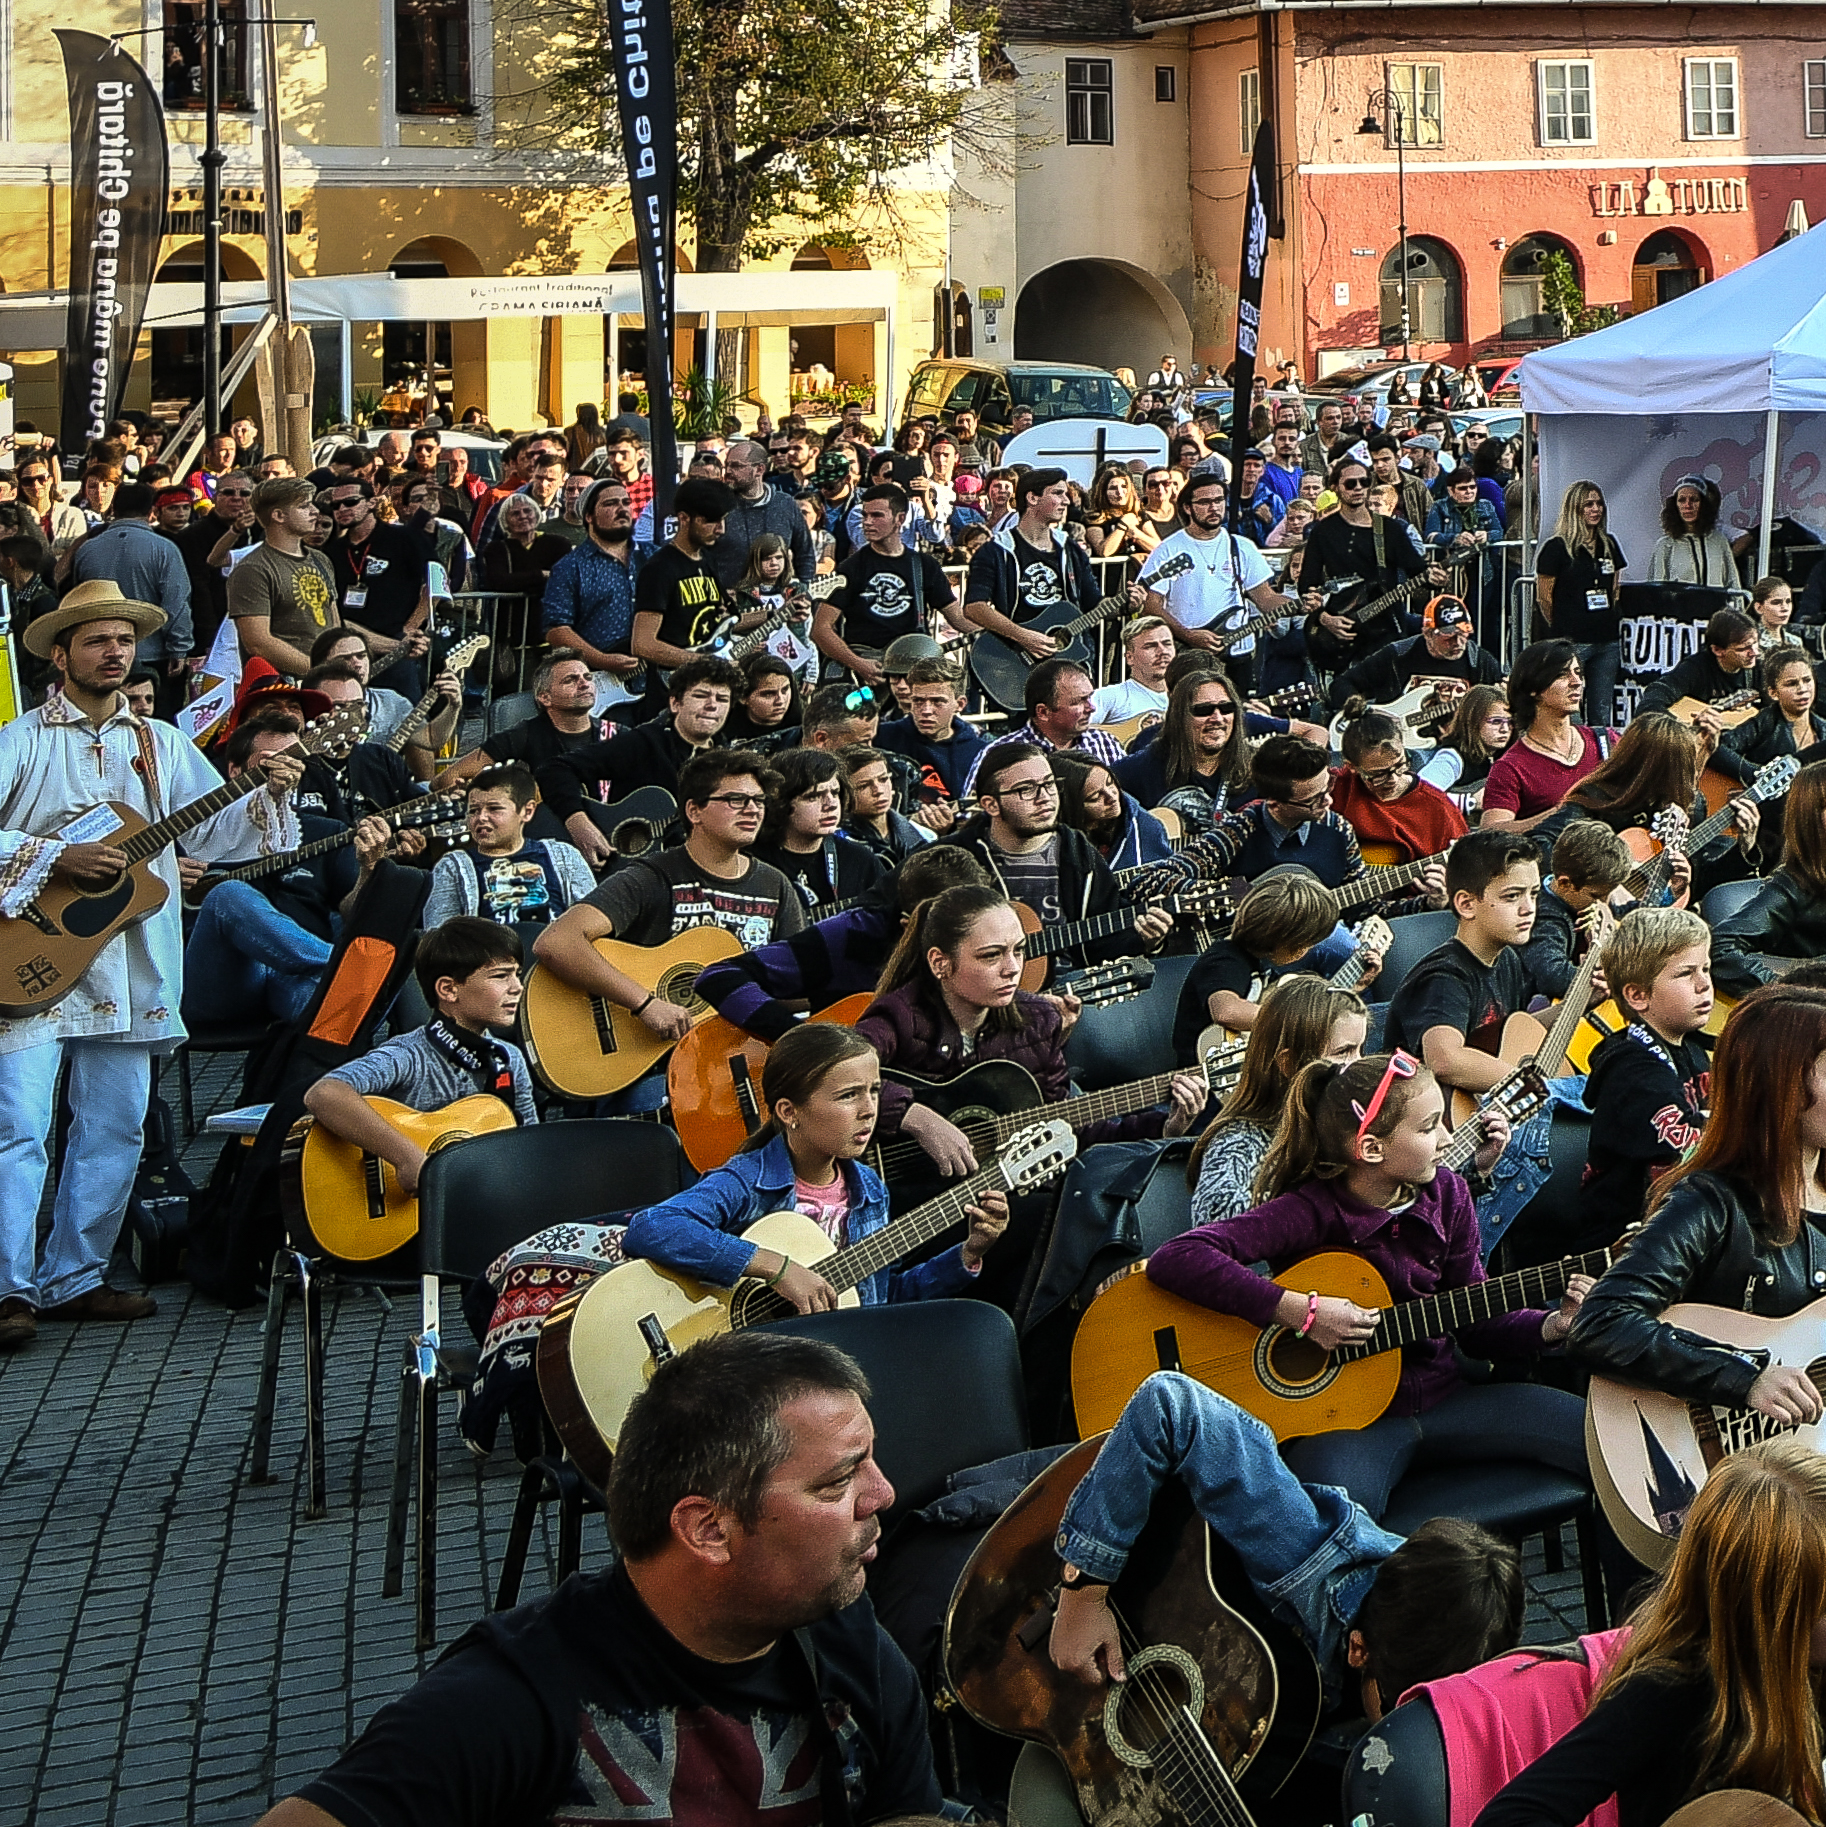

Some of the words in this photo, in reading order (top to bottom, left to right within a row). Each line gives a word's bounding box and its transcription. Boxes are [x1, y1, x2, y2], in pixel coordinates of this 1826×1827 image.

[1599, 180, 1639, 216] LA
[1674, 176, 1749, 214] TURN
[430, 1020, 460, 1051] Pune
